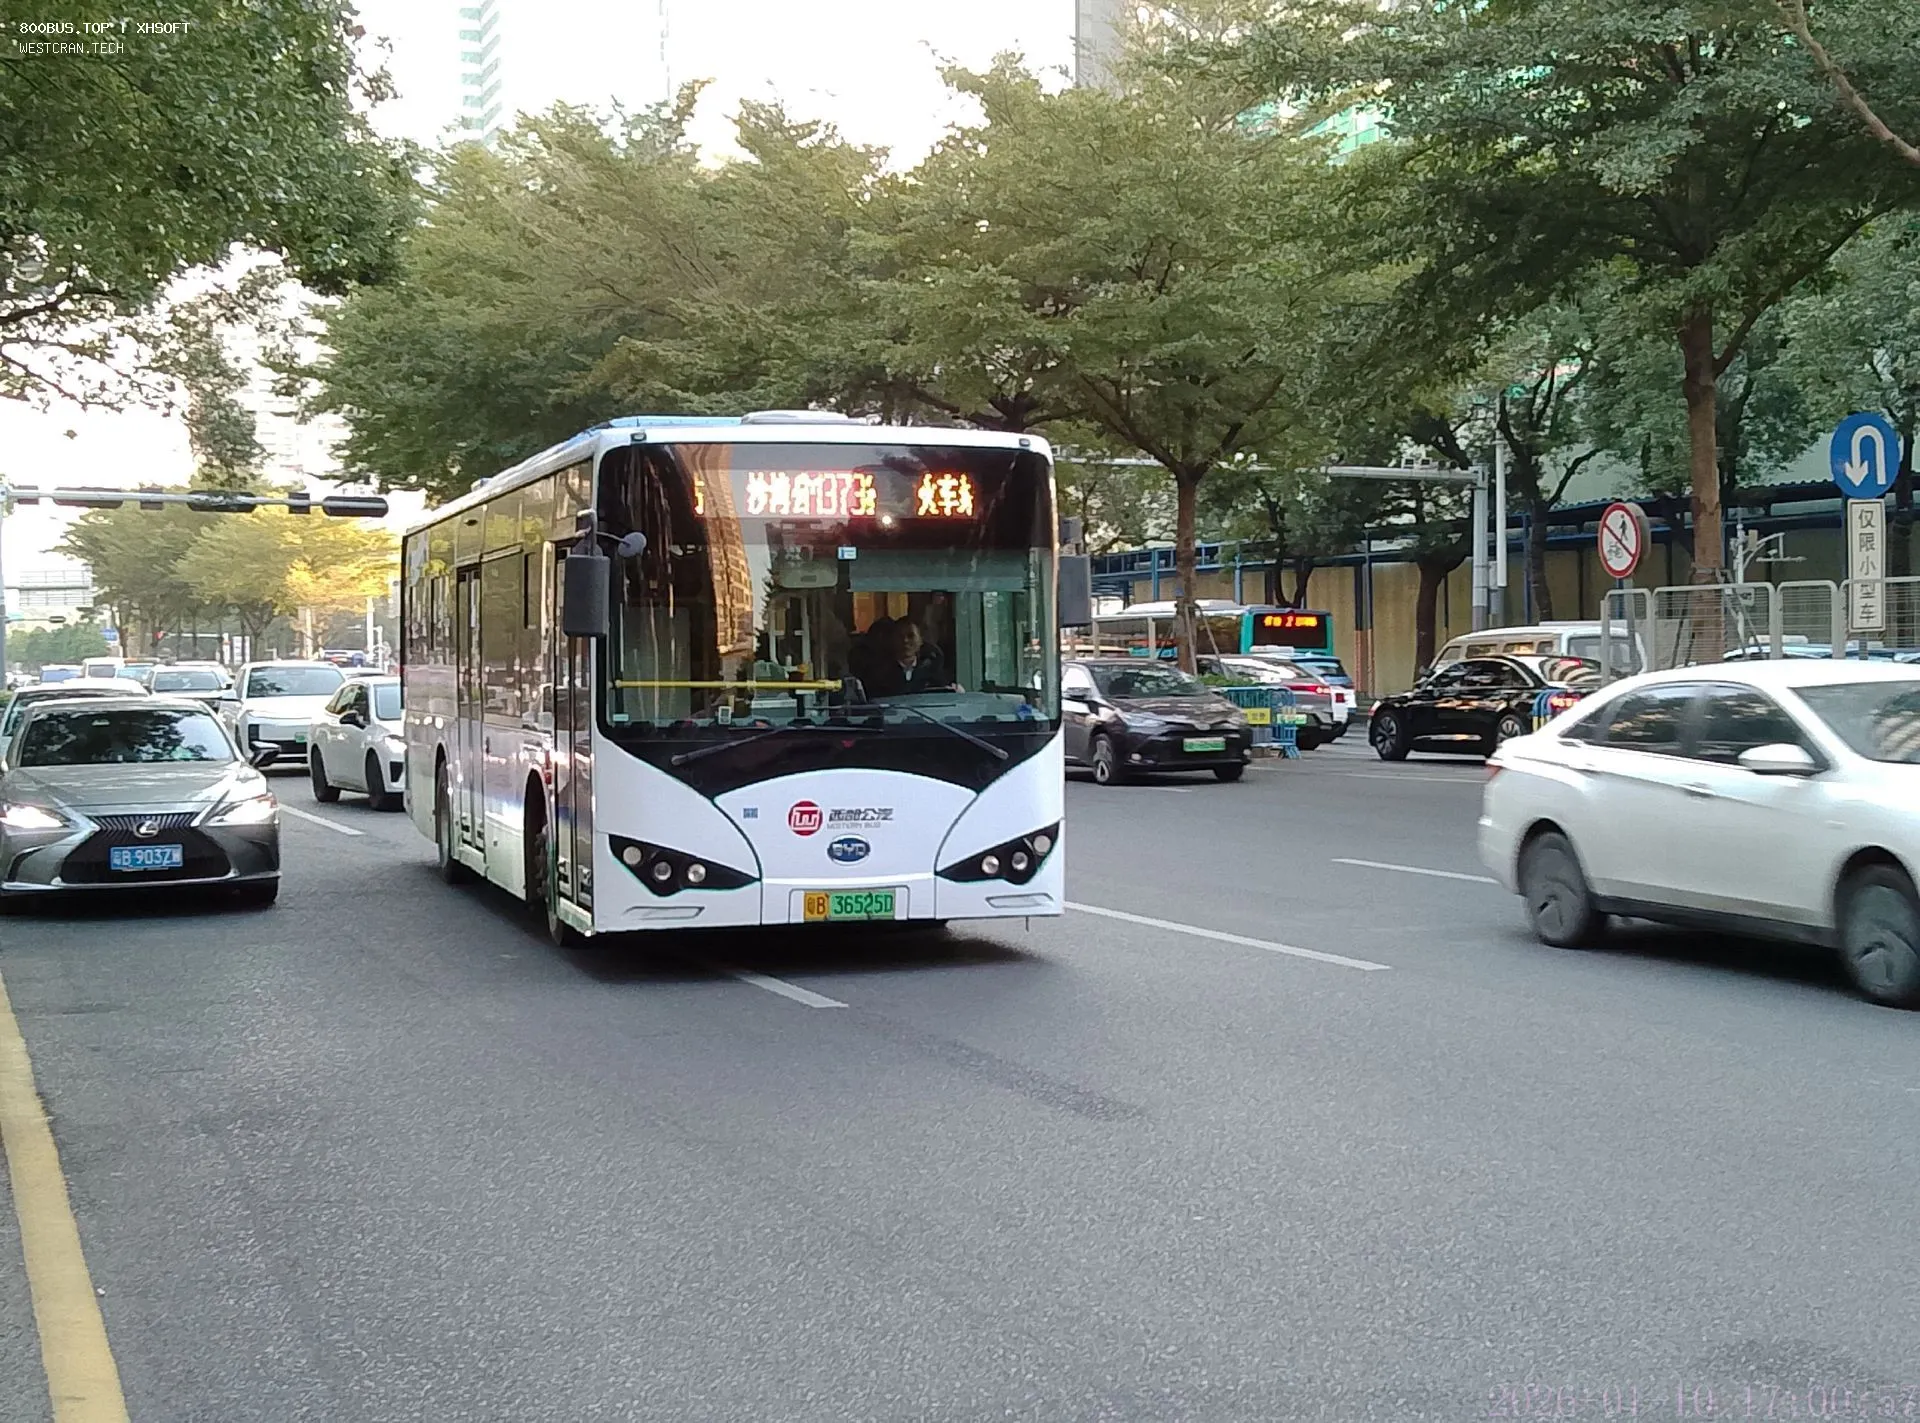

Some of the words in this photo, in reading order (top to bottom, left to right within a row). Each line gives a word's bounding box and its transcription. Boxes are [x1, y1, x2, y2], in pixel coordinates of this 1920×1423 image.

[1858, 508, 1877, 624] 仅限小型车
[832, 843, 866, 857] BYD
[834, 894, 894, 915] 36525D
